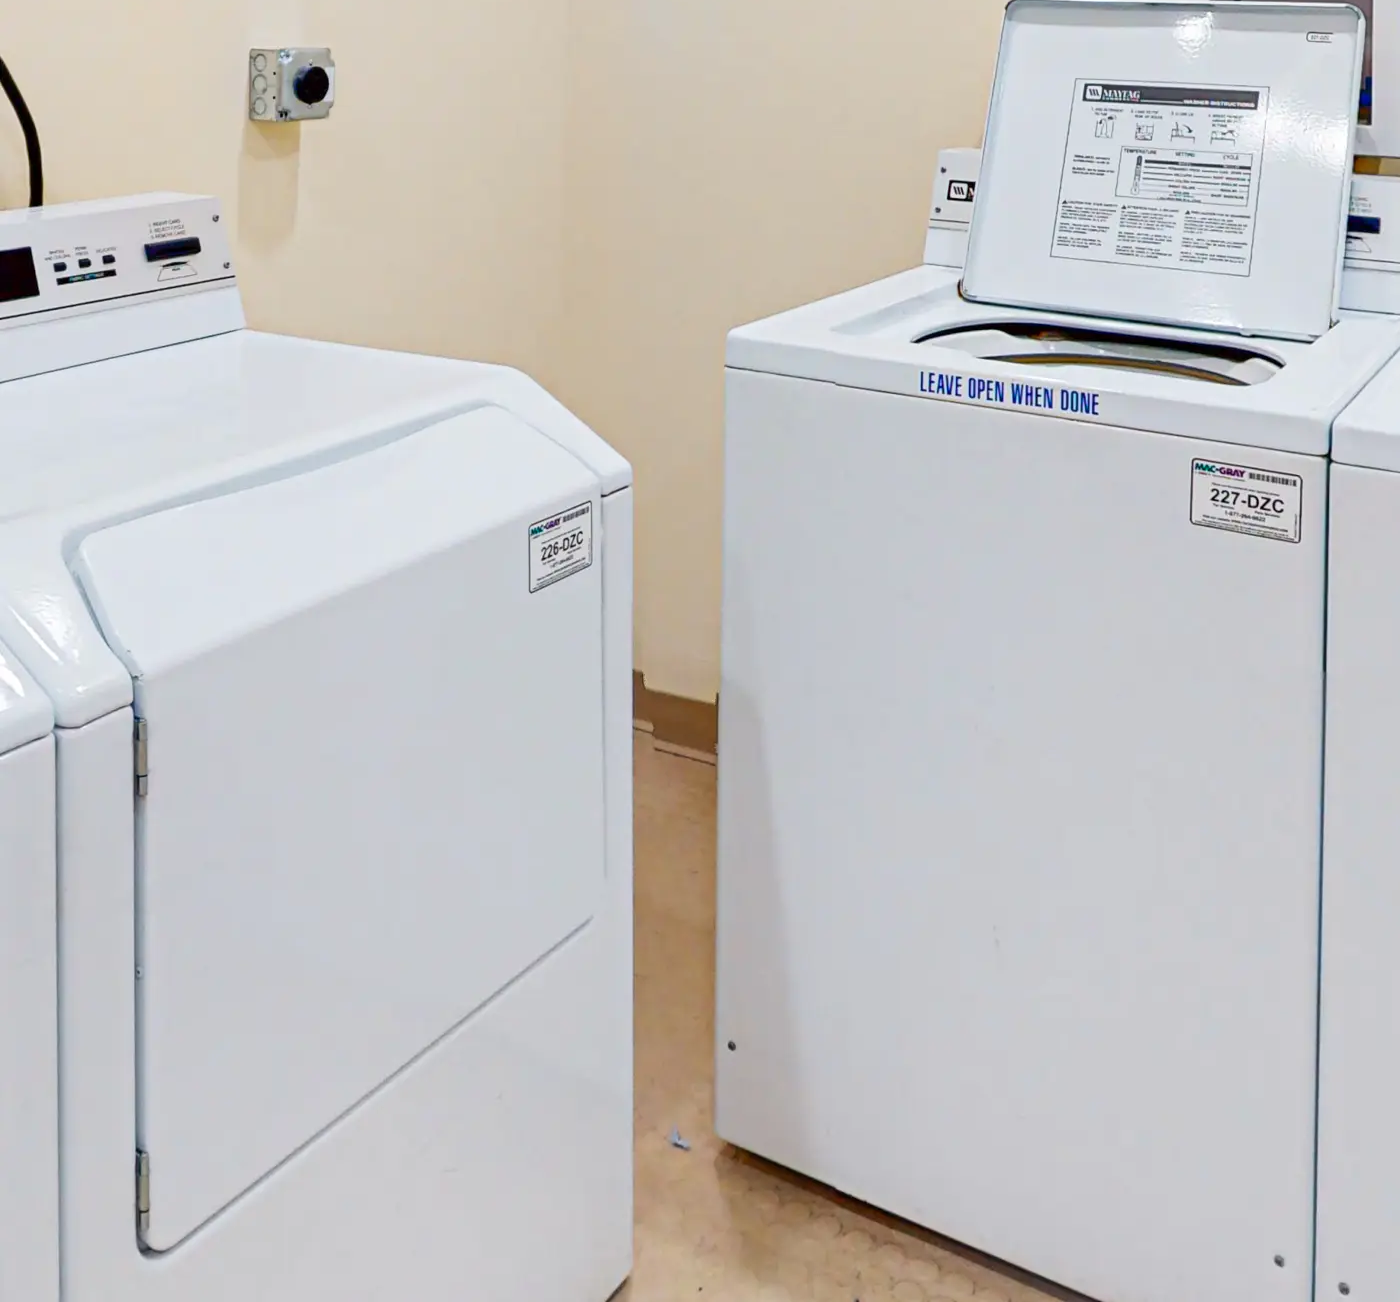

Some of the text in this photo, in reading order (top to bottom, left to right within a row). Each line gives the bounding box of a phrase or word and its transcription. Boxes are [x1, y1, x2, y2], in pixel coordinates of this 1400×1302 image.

[1102, 89, 1140, 101] MAYTAG
[920, 371, 1099, 415] LEAVE OPEN WHEN DONE
[1195, 462, 1246, 478] MAC-GRAY
[1210, 488, 1284, 514] 227-DZC
[541, 531, 583, 561] 226-DZC
